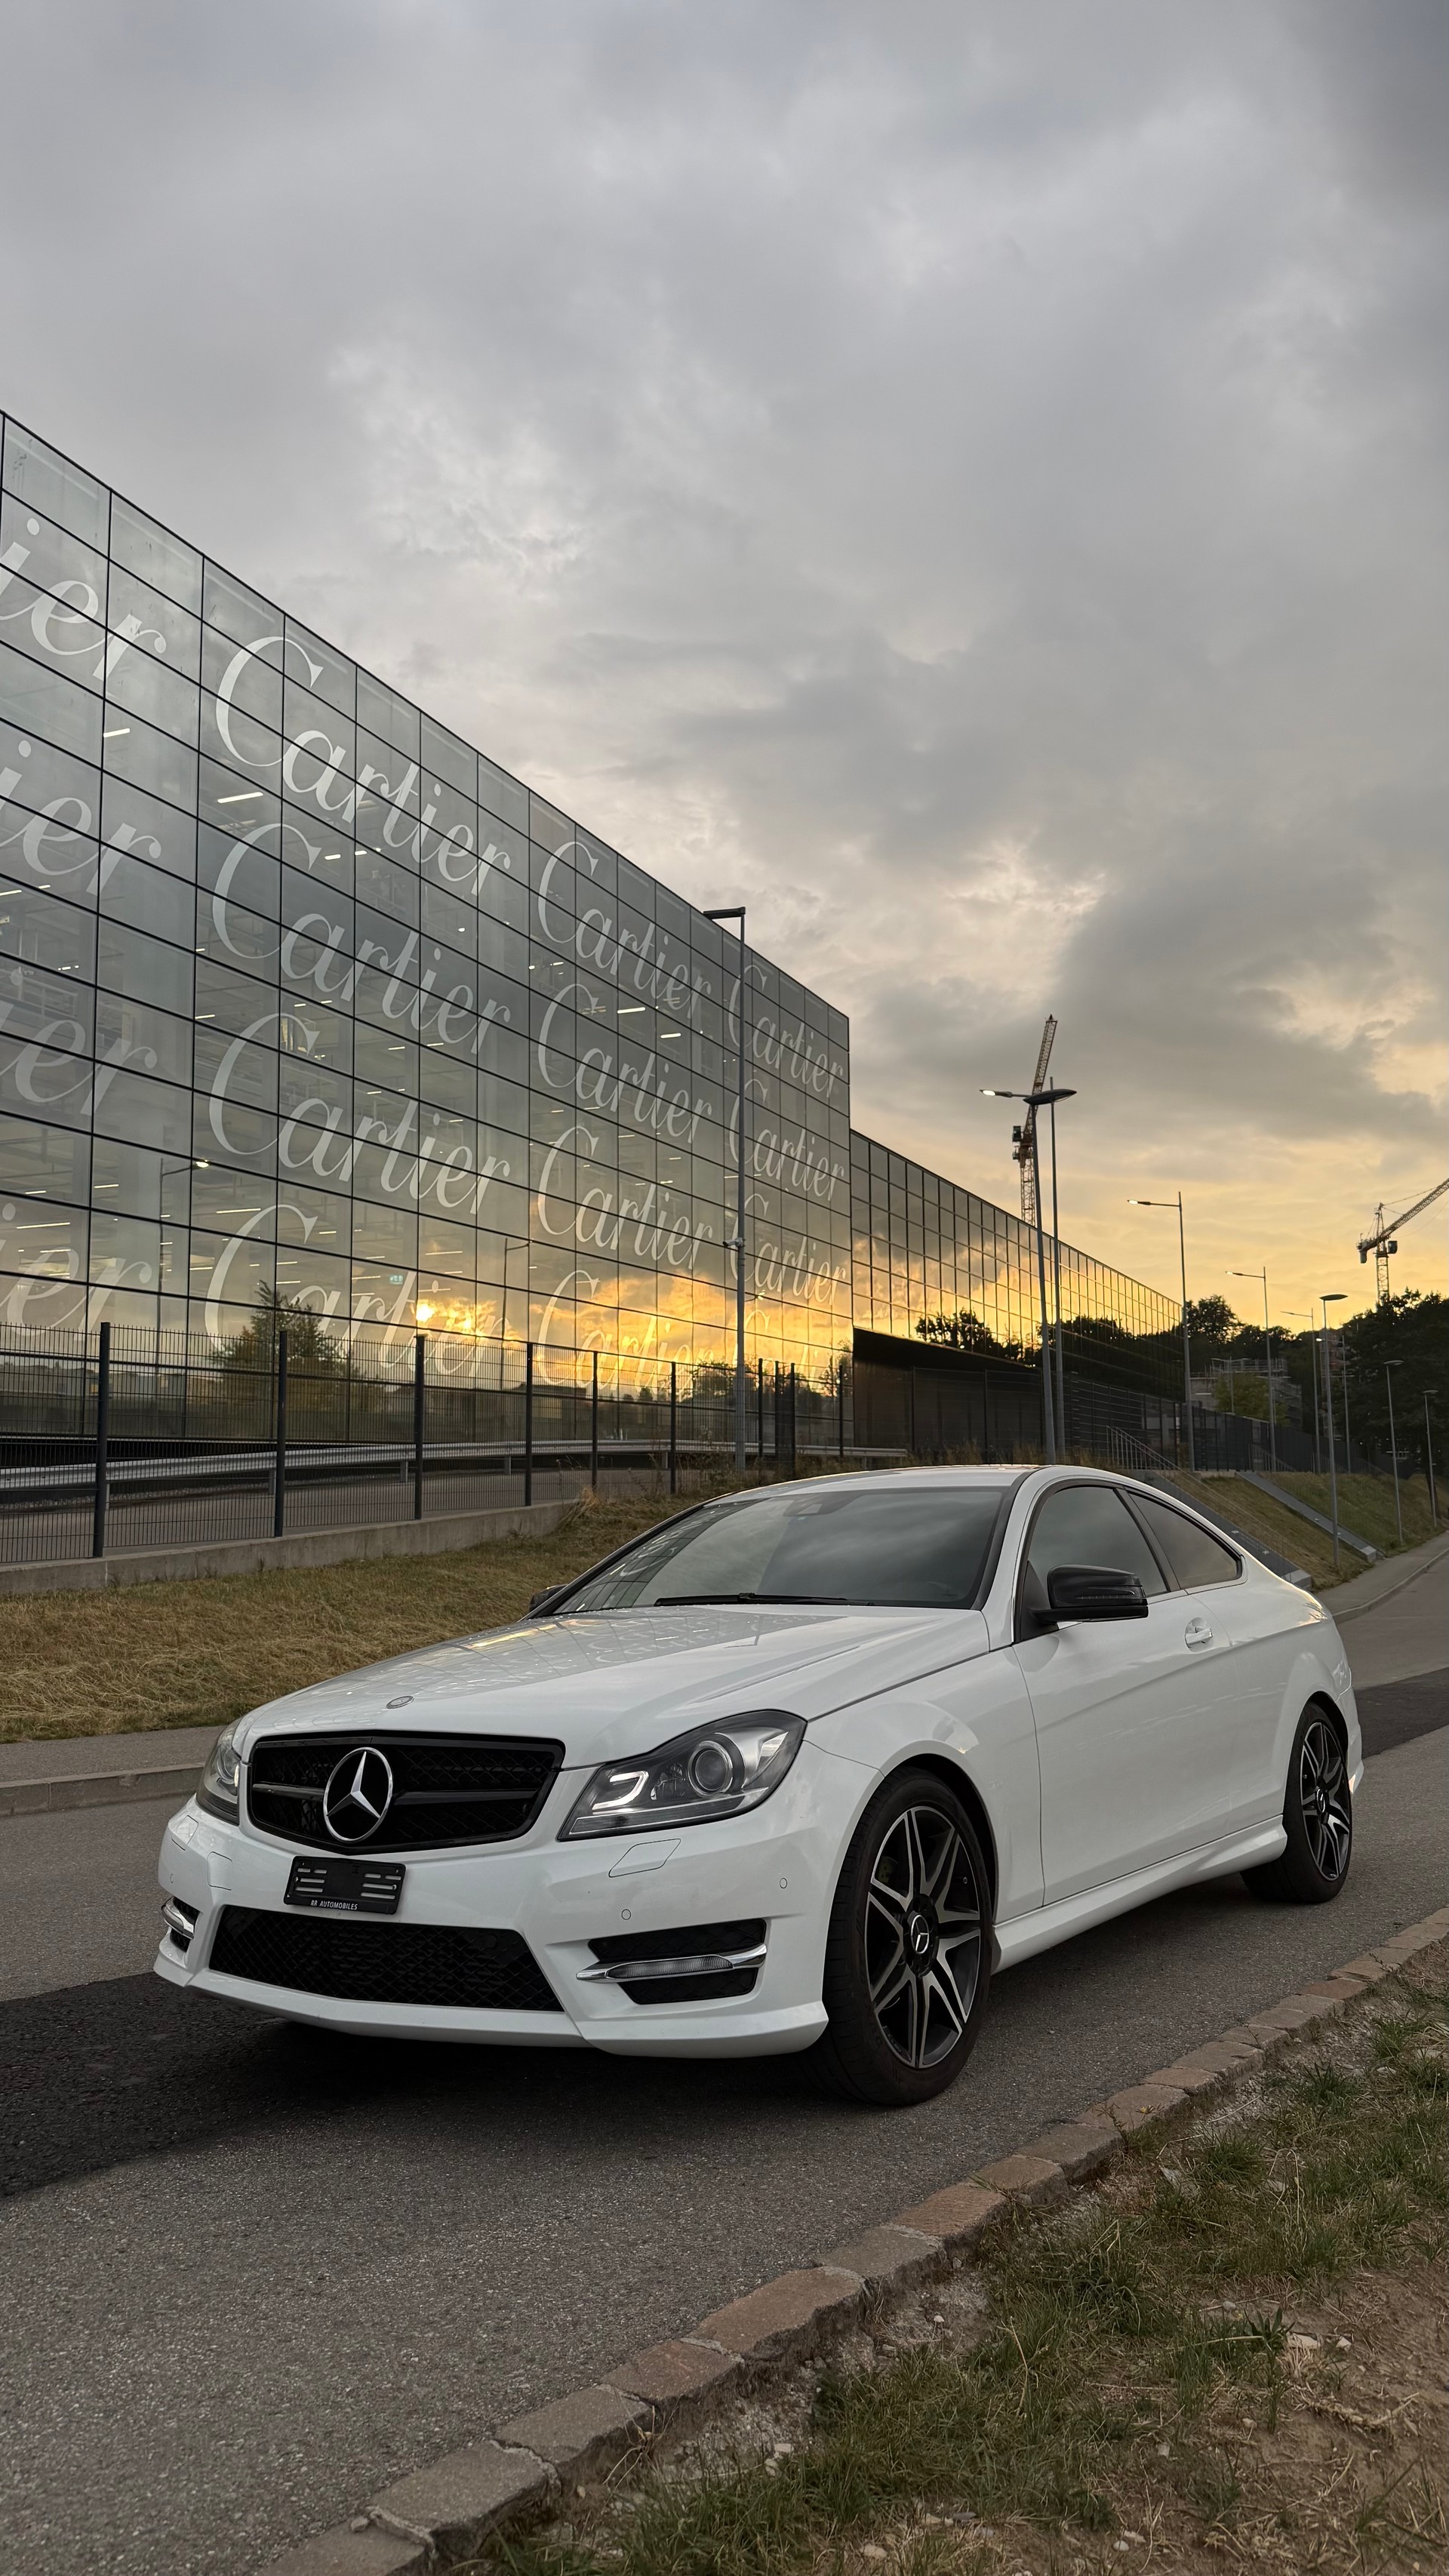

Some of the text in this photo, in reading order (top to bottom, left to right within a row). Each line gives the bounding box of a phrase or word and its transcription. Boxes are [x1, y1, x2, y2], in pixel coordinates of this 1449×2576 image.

[212, 823, 511, 1055] Cartier
[537, 983, 713, 1146] Cartier
[729, 1078, 845, 1202] Cartier
[215, 636, 512, 897] Cartier
[537, 841, 712, 1020] Cartier
[728, 963, 844, 1098] Cartier
[205, 1203, 510, 1379] Cartier
[208, 1013, 511, 1214] Cartier
[537, 1125, 713, 1270] Cartier
[729, 1193, 847, 1305] Cartier
[319, 1900, 358, 1910] AUTOMOBILES
